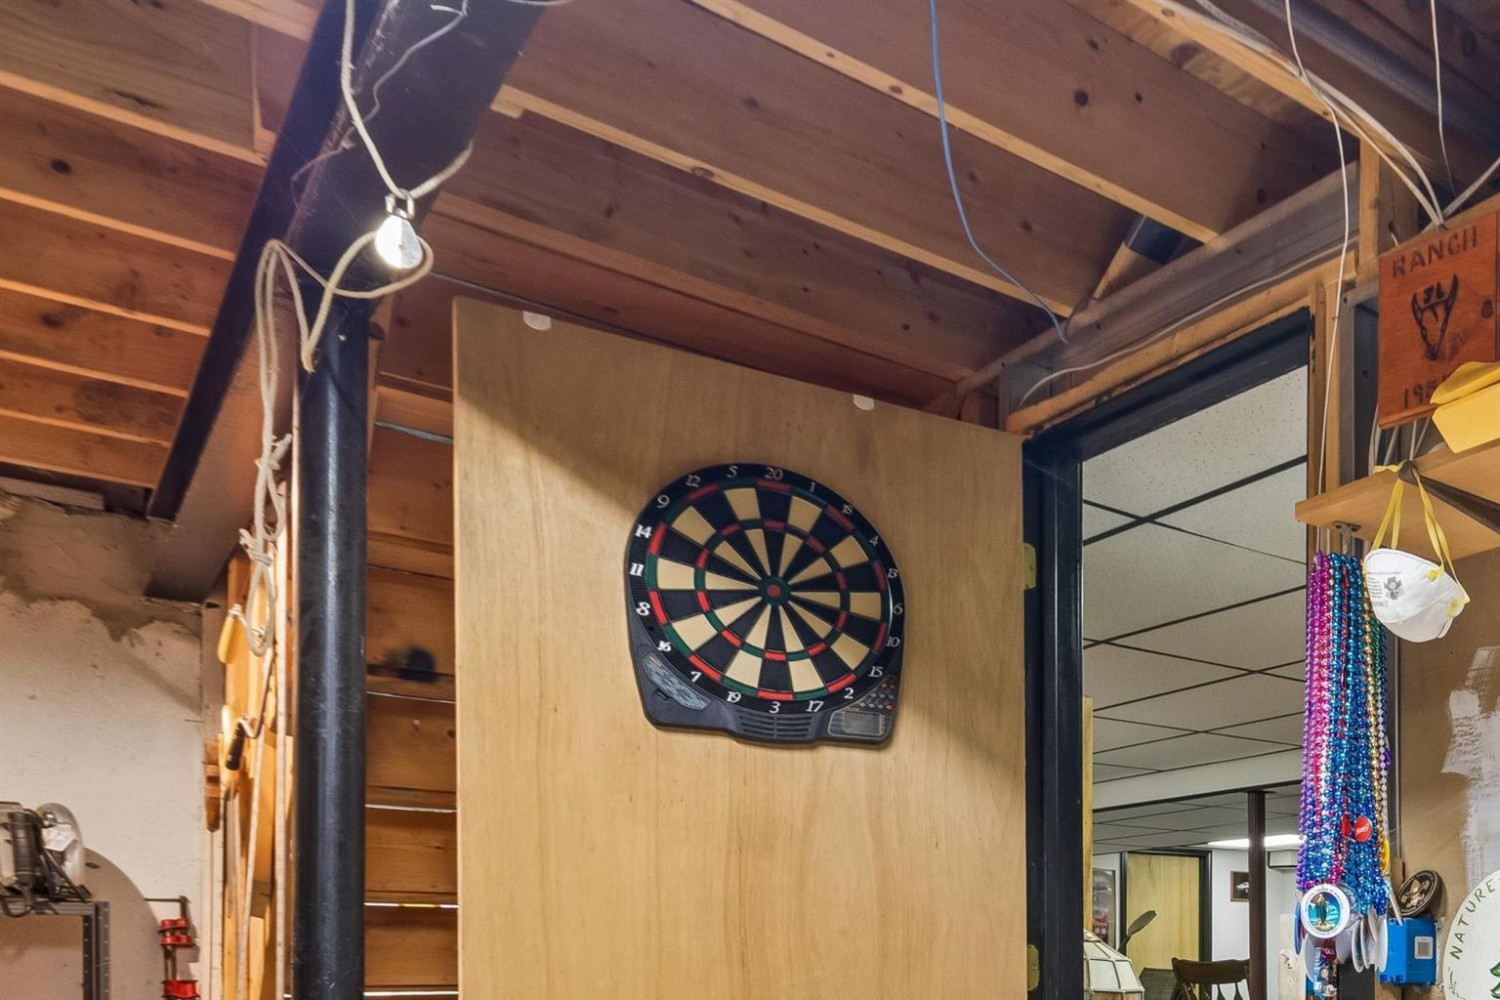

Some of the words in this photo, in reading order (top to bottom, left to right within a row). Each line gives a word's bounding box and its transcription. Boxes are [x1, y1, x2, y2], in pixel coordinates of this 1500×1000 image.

[1391, 225, 1478, 278] RANCH
[726, 465, 739, 478] 5
[764, 467, 784, 481] 20
[686, 474, 700, 488] 12
[657, 494, 670, 509] 9
[635, 524, 653, 539] 14
[868, 535, 880, 547] 4
[630, 563, 644, 577] 11
[635, 601, 650, 616] 8
[893, 603, 904, 614] 6
[658, 640, 672, 653] 16
[886, 636, 901, 648] 10
[690, 671, 703, 683] 7
[868, 666, 884, 678] 15
[726, 691, 742, 703] 19
[844, 687, 854, 699] 2
[769, 701, 780, 714] 3
[806, 700, 823, 713] 17
[1450, 878, 1497, 960] NATURE
